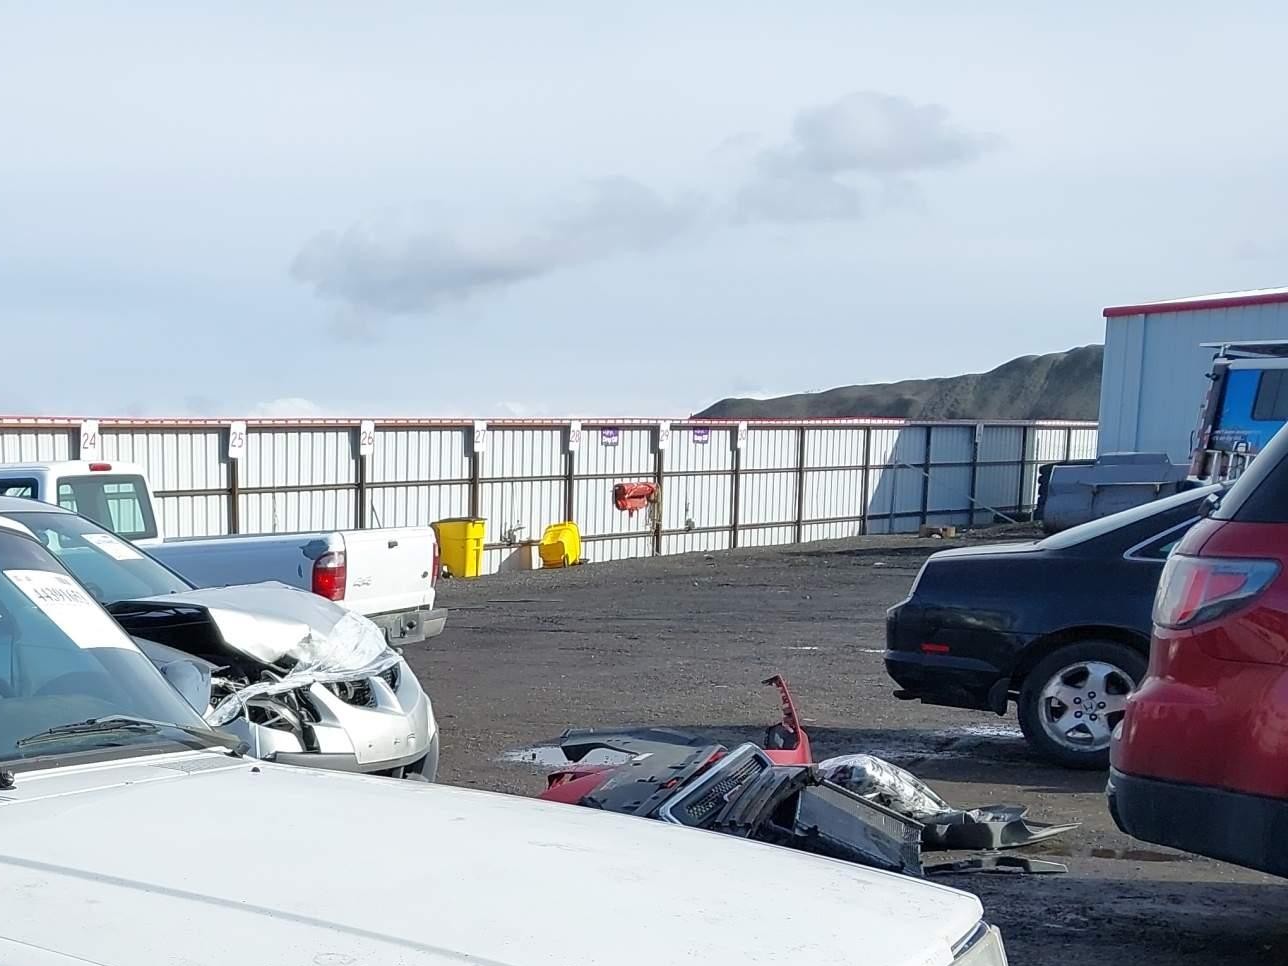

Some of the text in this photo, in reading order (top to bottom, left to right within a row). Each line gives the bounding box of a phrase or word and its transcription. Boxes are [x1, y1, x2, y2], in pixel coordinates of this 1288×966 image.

[82, 432, 96, 449] 24
[231, 431, 243, 448] 25
[361, 431, 374, 446] 26
[474, 430, 486, 443] 27
[569, 430, 581, 443] 28
[660, 429, 670, 441] 29
